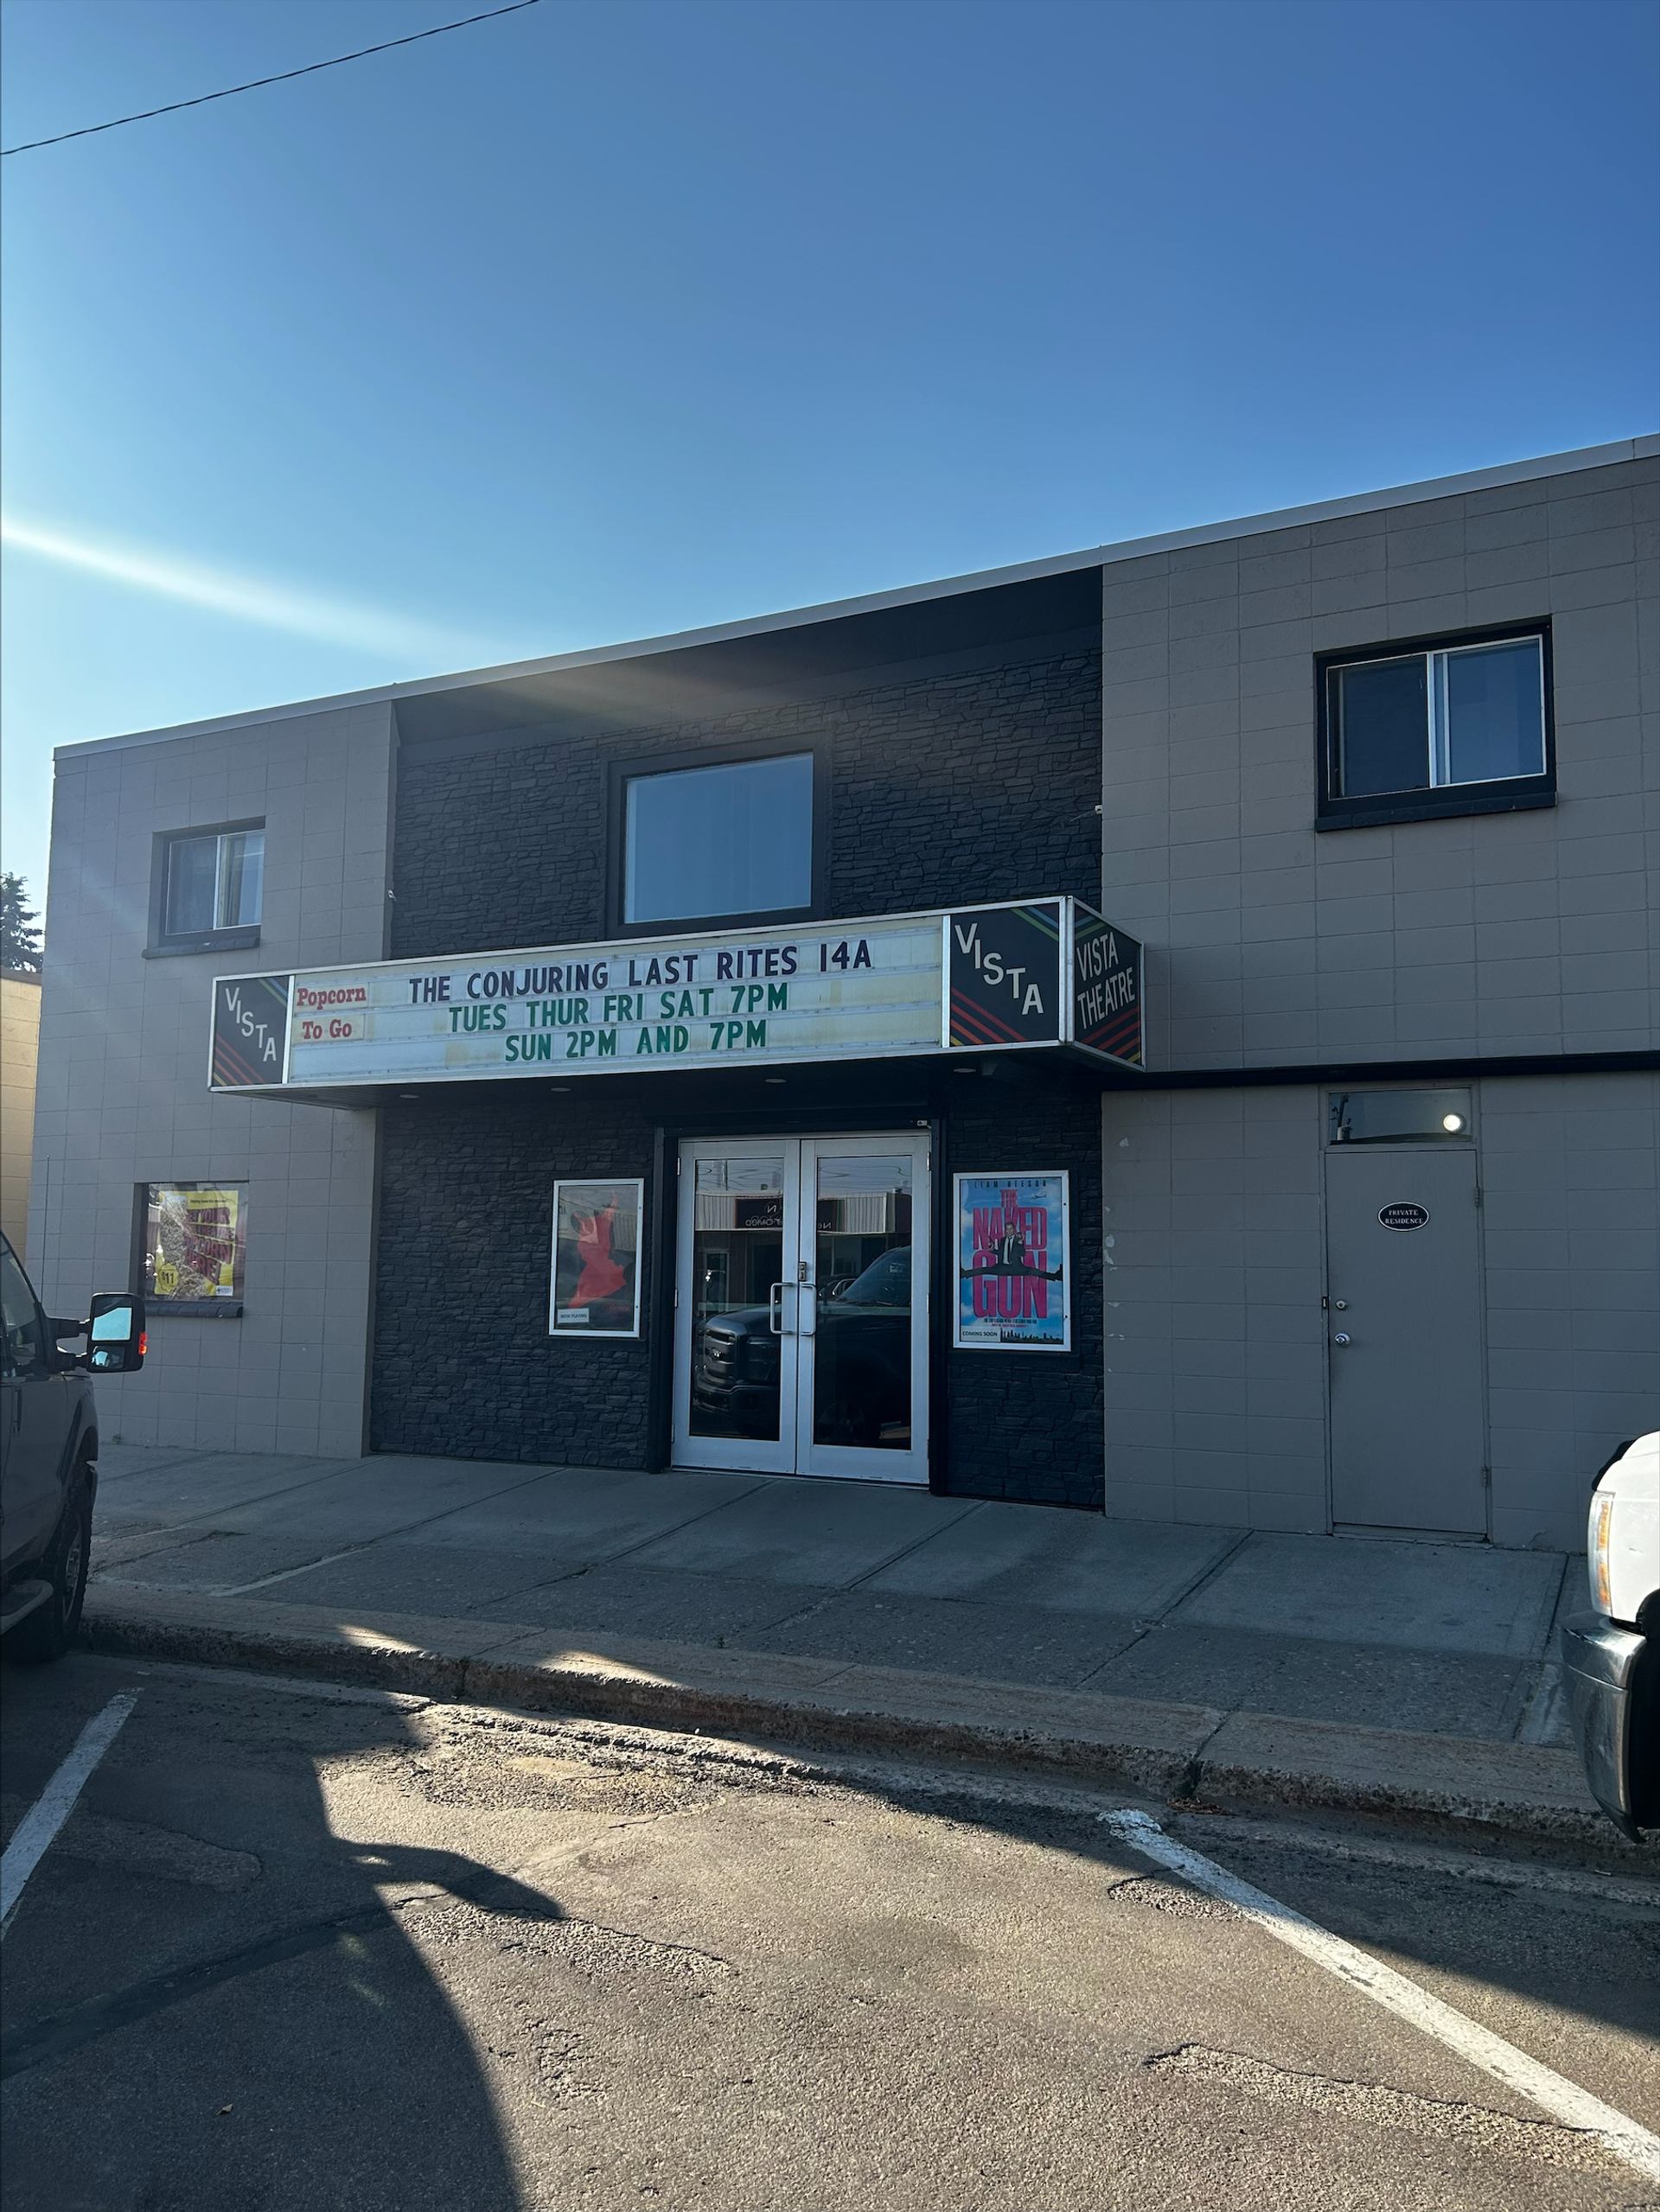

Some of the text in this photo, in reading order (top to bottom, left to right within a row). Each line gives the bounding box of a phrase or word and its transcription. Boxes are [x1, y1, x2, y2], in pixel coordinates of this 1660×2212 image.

[409, 940, 872, 1003] THE CONJURING LAST RITES 14A
[954, 922, 1044, 1015] VISTA
[1076, 932, 1119, 981] VISTA
[297, 986, 367, 1010] Popcorn
[449, 982, 788, 1032] TUES THUR FRI SAT 7PM
[1077, 966, 1135, 1030] THEATRE
[225, 987, 277, 1061] VISTA
[303, 1019, 352, 1039] To Go
[505, 1019, 766, 1061] SUN 2PM AND 7PM
[162, 1272, 175, 1284] $11
[972, 1250, 1048, 1318] GUN
